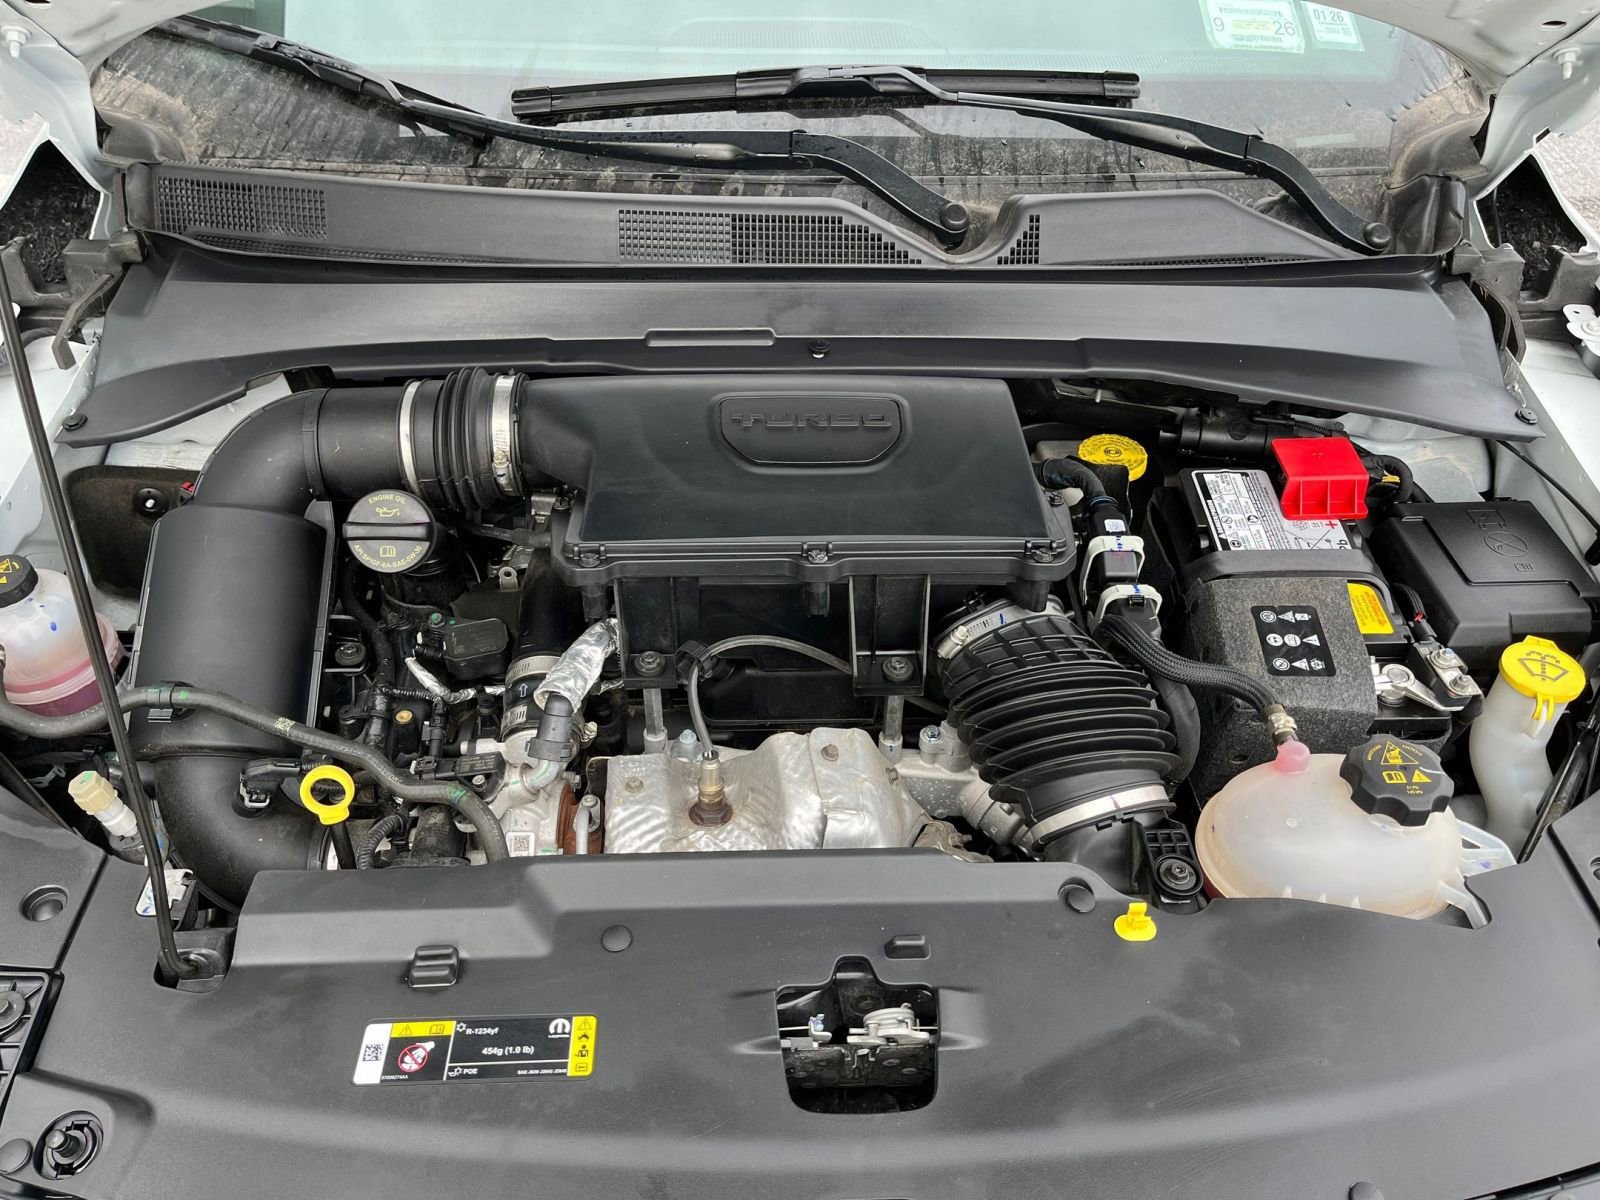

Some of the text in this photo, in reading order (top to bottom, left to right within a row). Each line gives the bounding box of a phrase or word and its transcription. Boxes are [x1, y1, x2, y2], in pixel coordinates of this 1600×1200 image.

[1329, 10, 1344, 22] 26
[1213, 17, 1225, 32] 9
[1272, 20, 1296, 36] 26
[731, 413, 892, 429] TURBO
[368, 494, 406, 505] ENGINE OIL
[466, 1027, 499, 1036] R-1234yf
[481, 1045, 535, 1056] 454g (1.0 lb)
